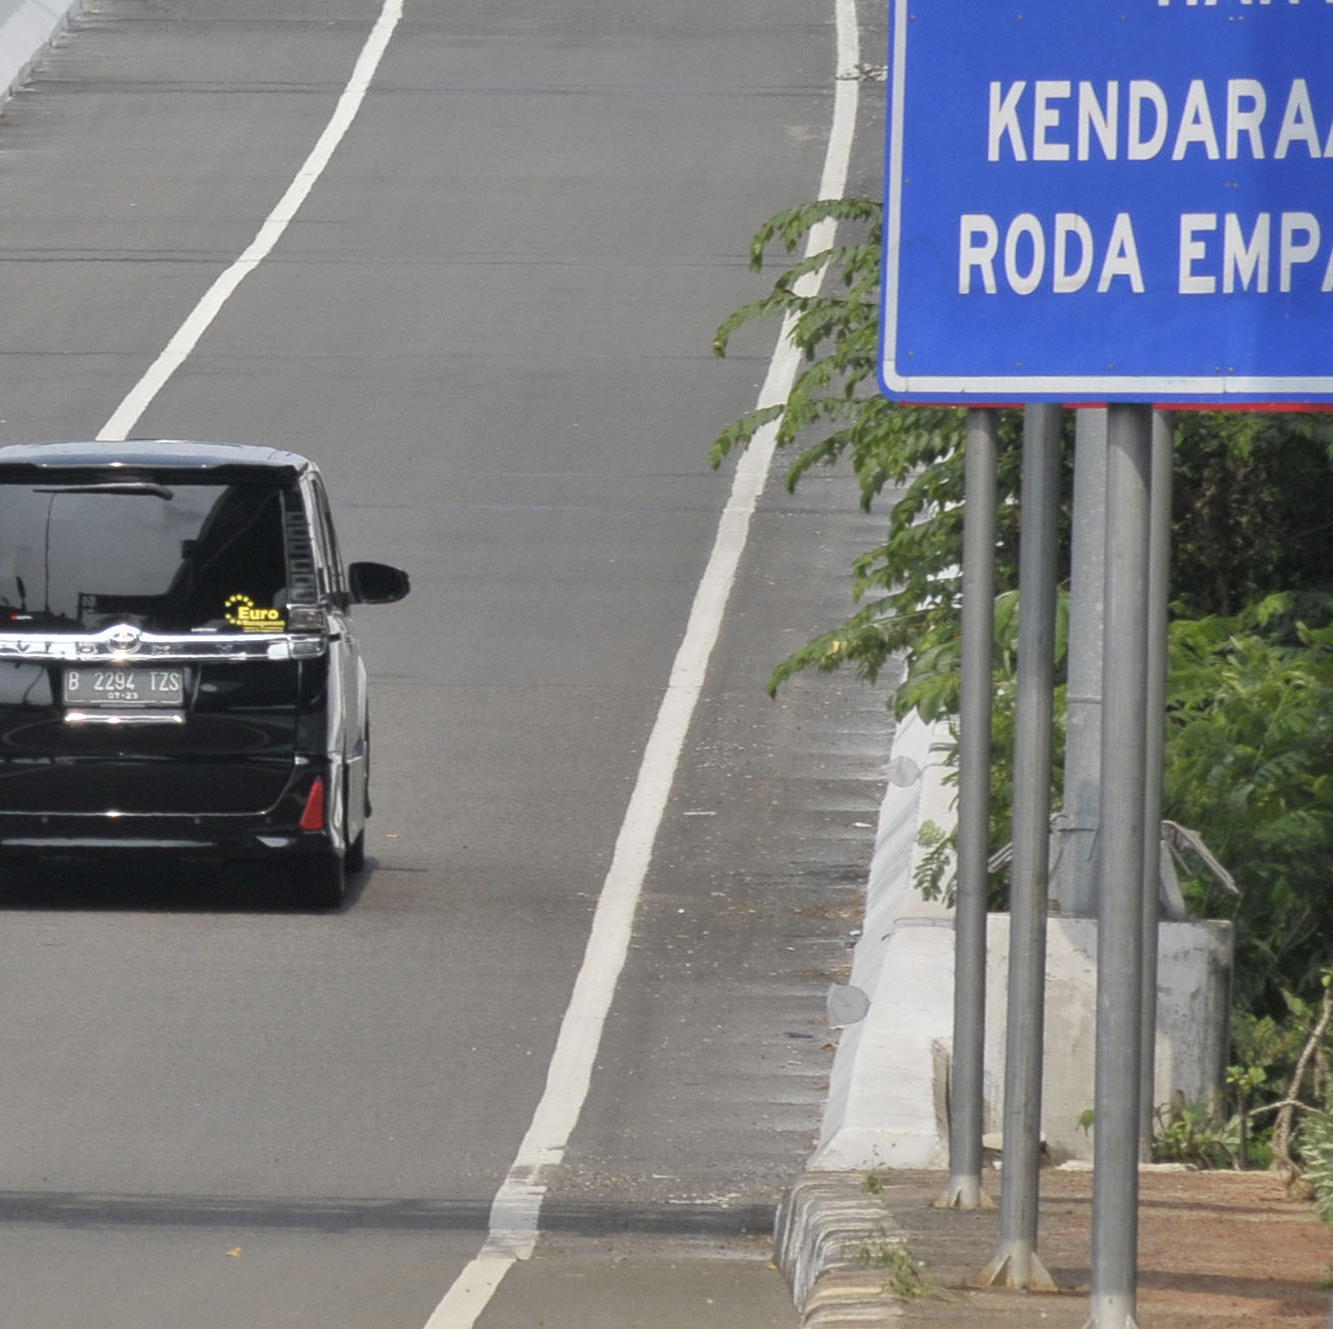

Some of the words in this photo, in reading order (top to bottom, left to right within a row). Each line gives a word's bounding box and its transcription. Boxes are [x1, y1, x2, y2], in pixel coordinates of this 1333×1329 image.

[988, 78, 1333, 163] KENDARA
[958, 212, 1146, 297] RODA
[1177, 210, 1333, 296] EMP
[237, 606, 279, 620] Euro
[69, 672, 80, 691] B
[94, 672, 135, 691] 2294
[149, 672, 181, 692] TZS
